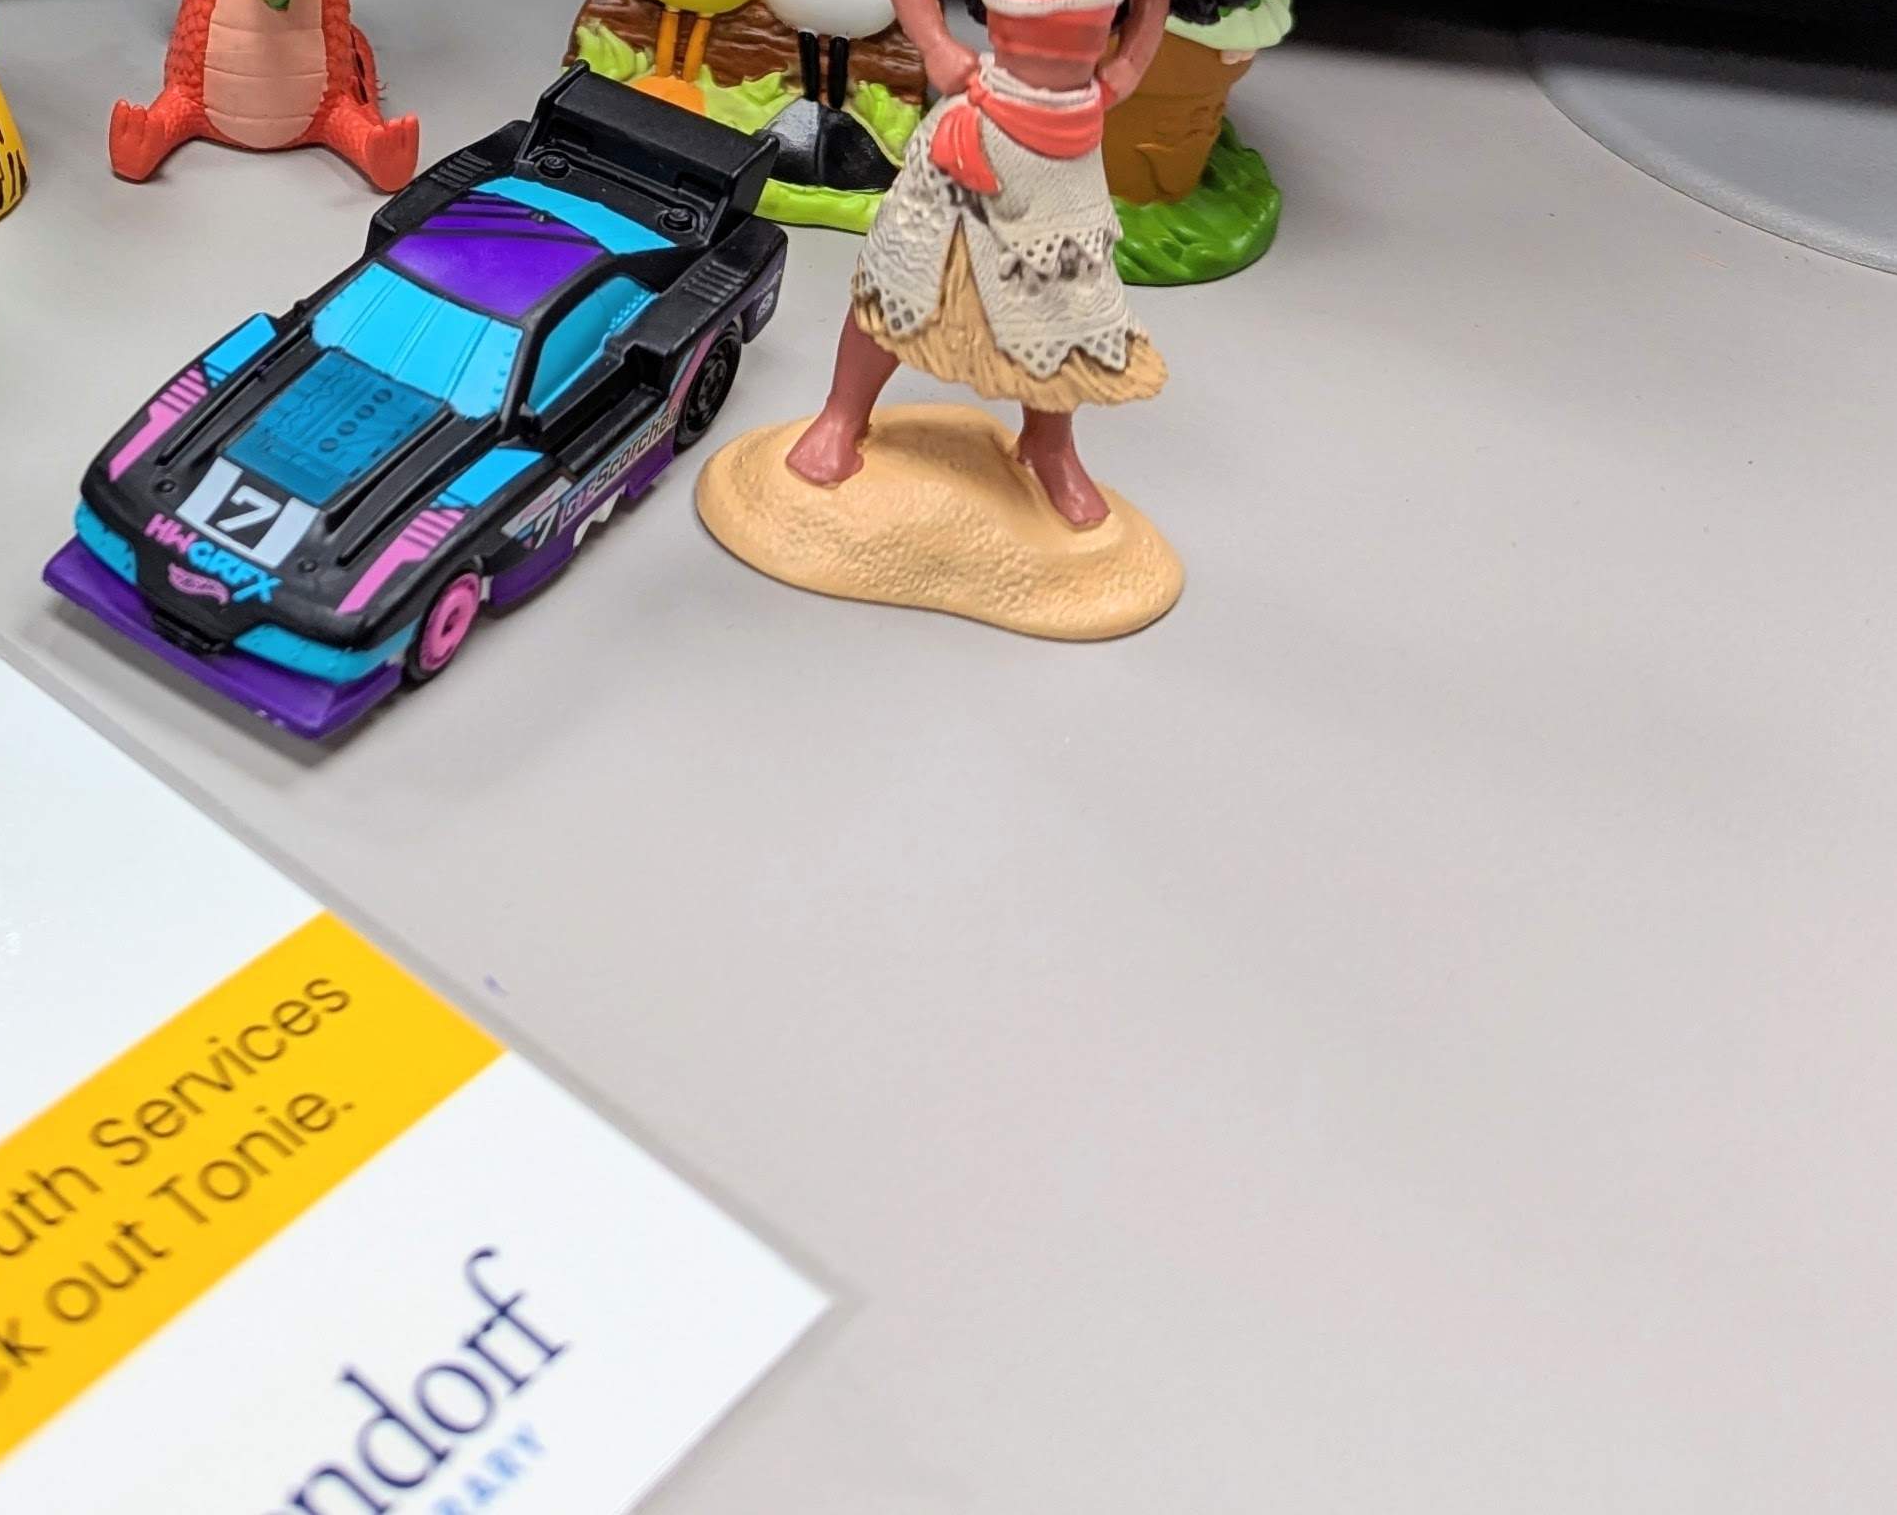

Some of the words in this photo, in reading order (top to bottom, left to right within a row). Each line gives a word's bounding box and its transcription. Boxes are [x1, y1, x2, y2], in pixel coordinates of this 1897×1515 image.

[89, 970, 352, 1167] Services
[45, 1215, 174, 1326] out
[150, 1090, 357, 1230] Tonie.
[267, 1246, 572, 1515] ndorf
